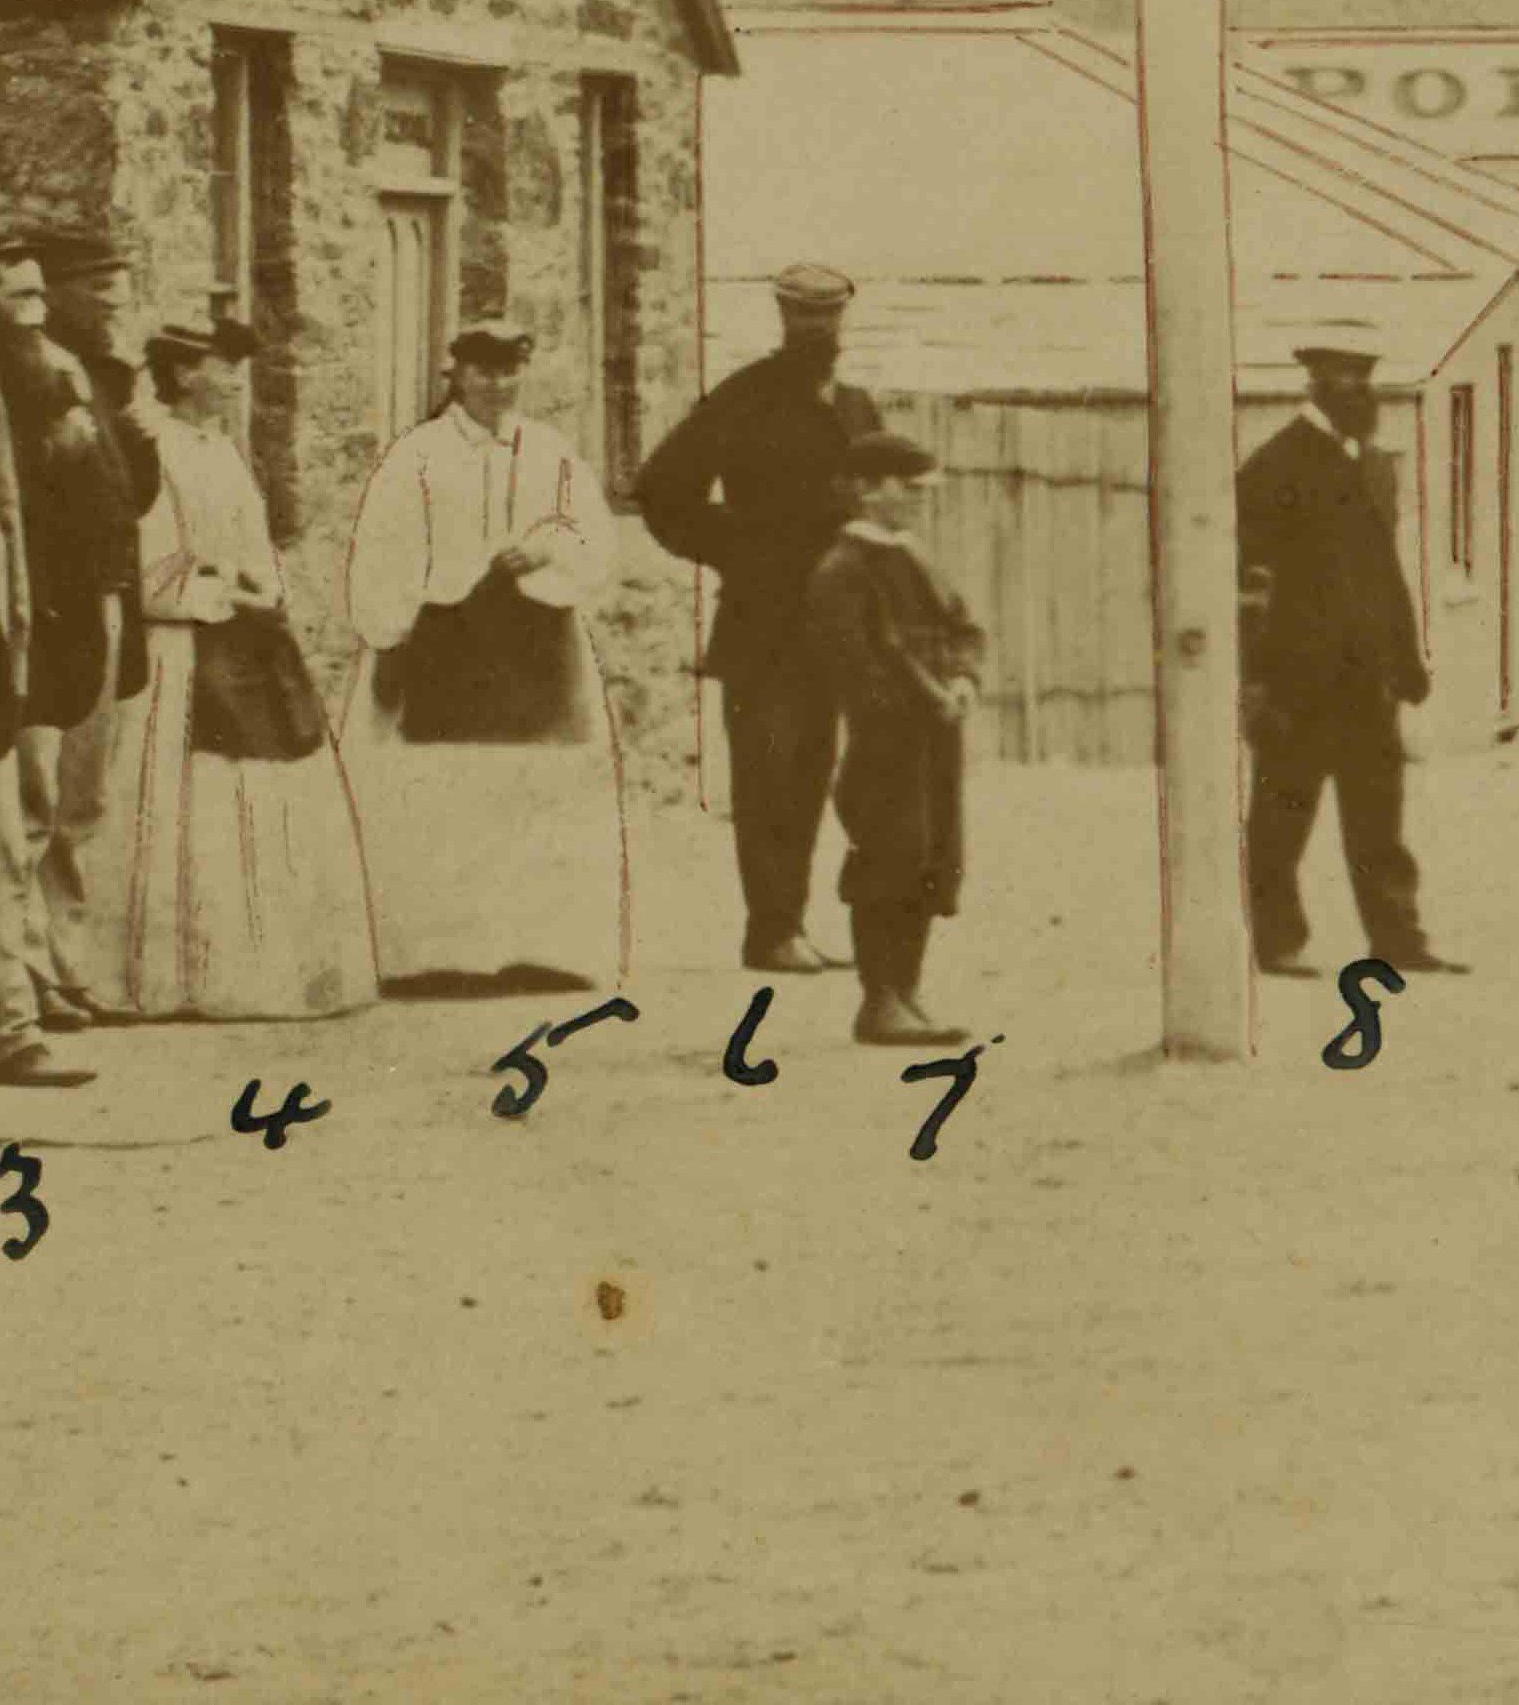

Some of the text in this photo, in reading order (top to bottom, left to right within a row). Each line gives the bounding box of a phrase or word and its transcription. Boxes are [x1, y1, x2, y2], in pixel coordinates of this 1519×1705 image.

[1322, 958, 1406, 1069] 8
[231, 1079, 332, 1149] 4
[902, 1035, 982, 1160] 7
